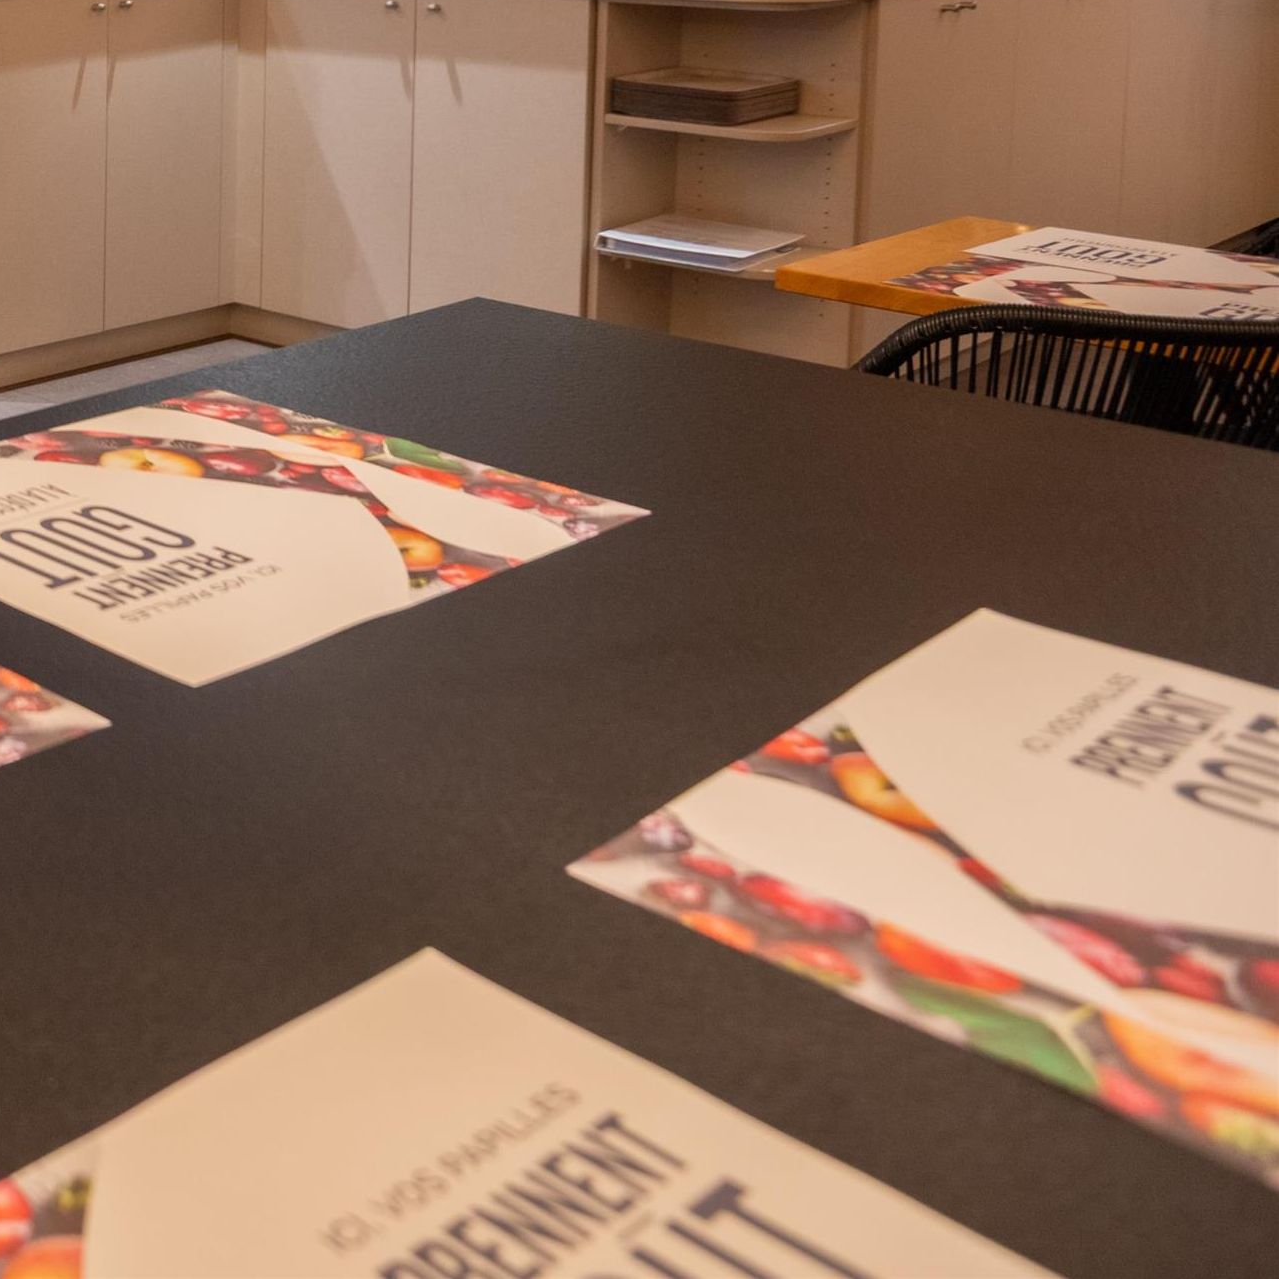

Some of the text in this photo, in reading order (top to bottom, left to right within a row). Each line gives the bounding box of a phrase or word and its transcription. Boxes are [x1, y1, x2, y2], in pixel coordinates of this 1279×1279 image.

[72, 545, 255, 611] PRENNENT
[1068, 683, 1236, 790] PRENNENT
[371, 1165, 450, 1222] VOS
[440, 1079, 584, 1180] PAPILLES
